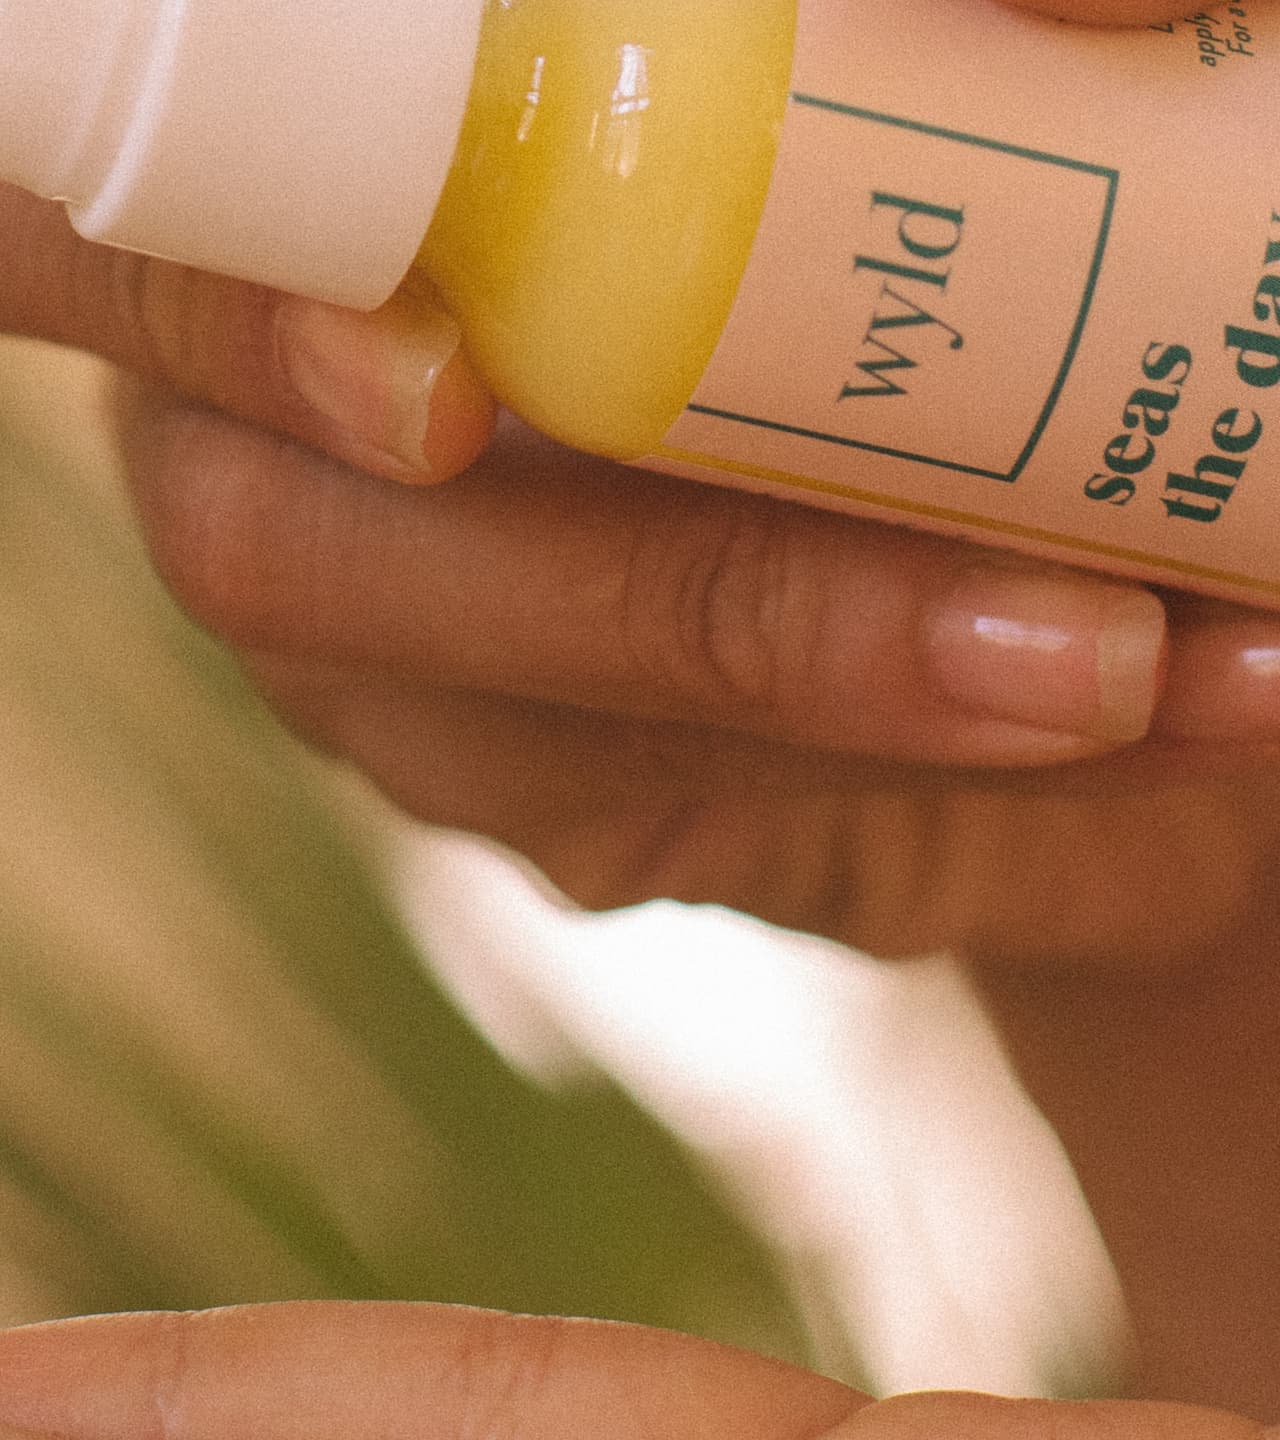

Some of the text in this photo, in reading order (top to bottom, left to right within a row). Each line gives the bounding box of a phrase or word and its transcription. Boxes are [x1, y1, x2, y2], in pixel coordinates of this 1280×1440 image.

[1184, 12, 1226, 67] apply
[1225, 22, 1255, 57] For
[835, 190, 965, 404] wyld
[1083, 340, 1193, 507] seas
[1160, 407, 1264, 523] the
